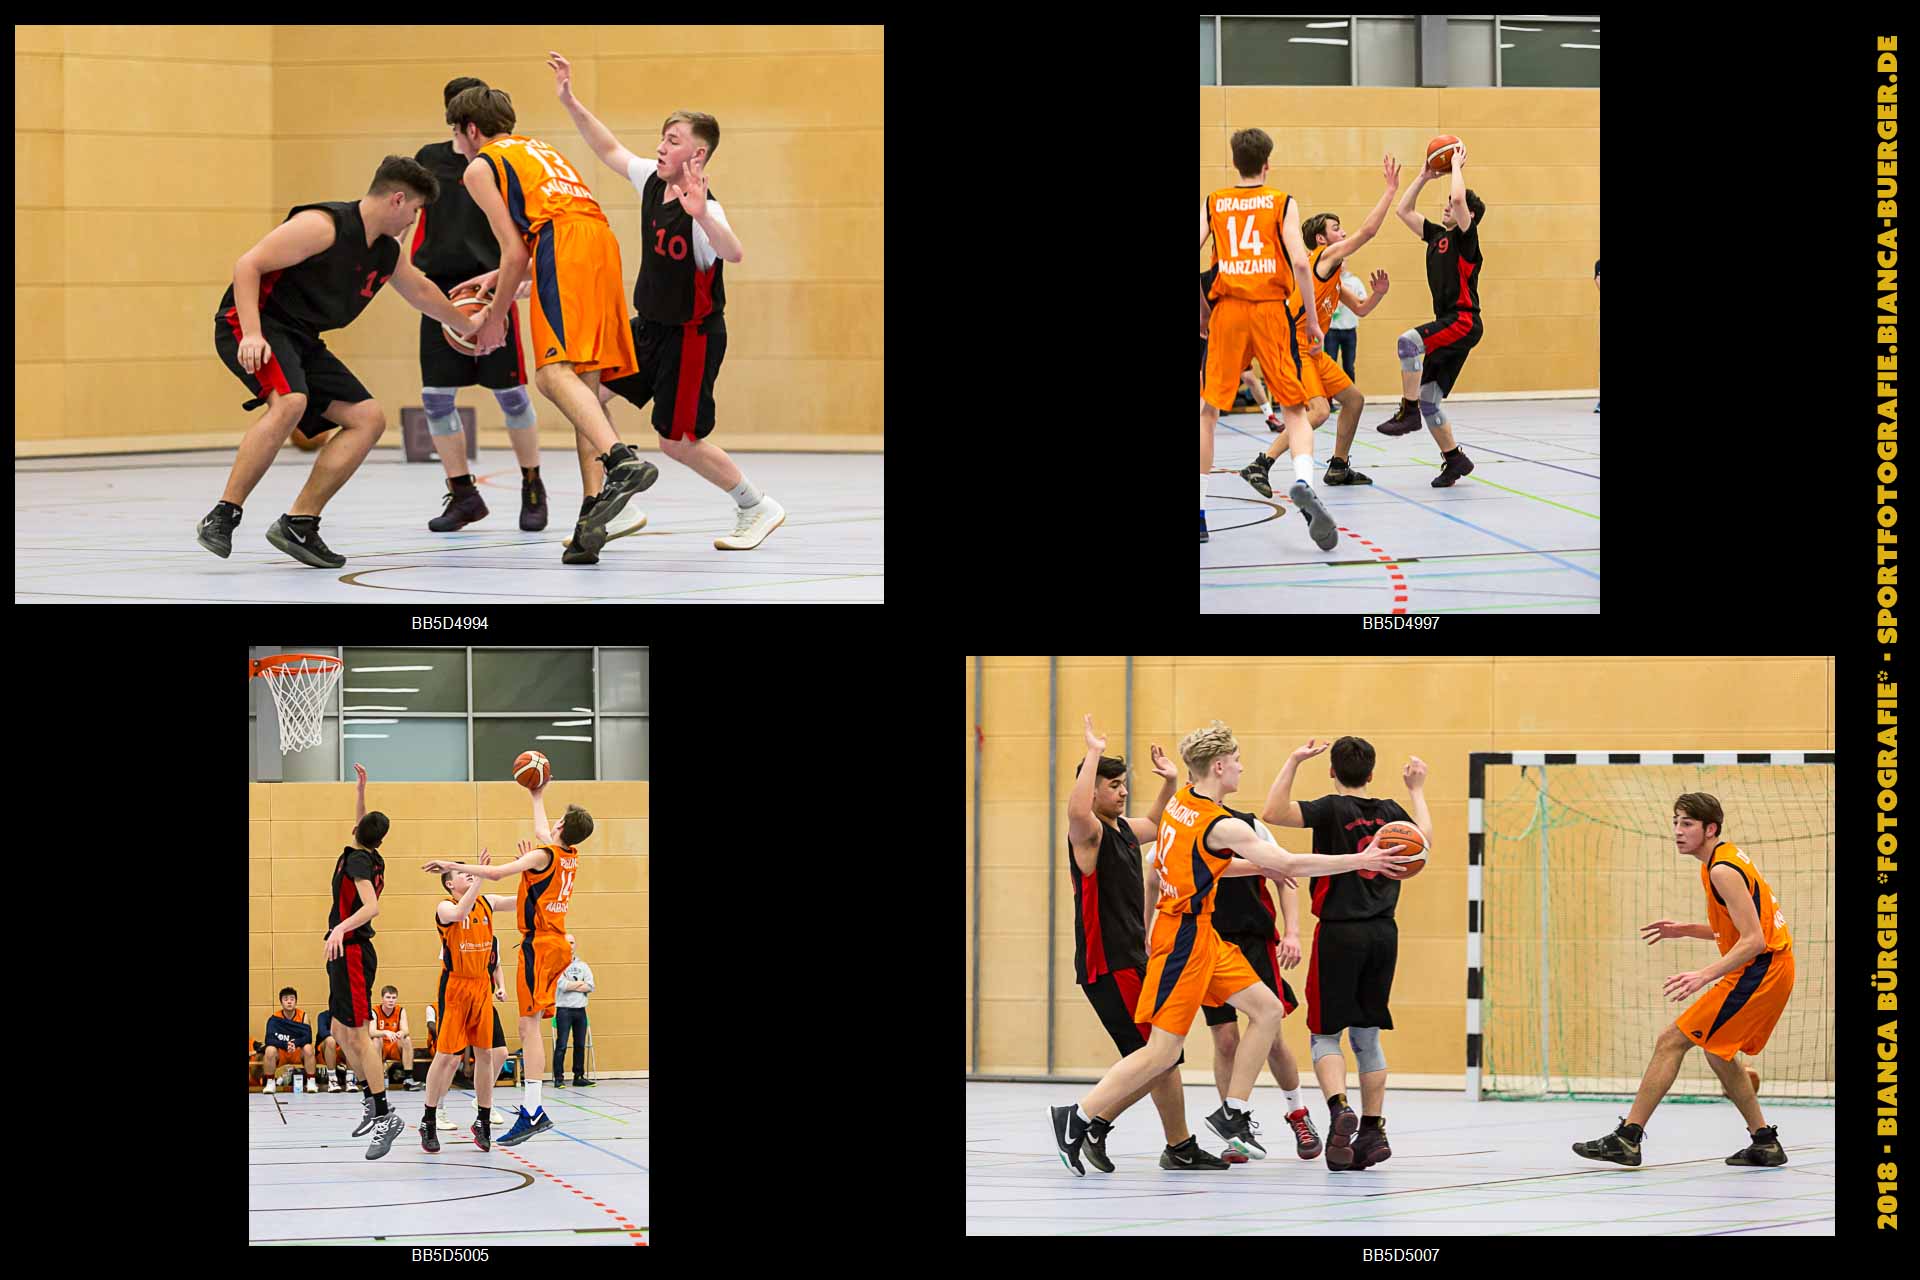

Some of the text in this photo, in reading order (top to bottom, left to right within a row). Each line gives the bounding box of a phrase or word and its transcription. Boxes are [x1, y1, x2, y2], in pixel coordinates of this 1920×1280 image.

[524, 145, 580, 183] 13
[1215, 194, 1275, 213] DRAGONS
[654, 229, 688, 261] 10
[1226, 214, 1265, 258] 14
[1438, 237, 1449, 254] 9
[1217, 259, 1277, 275] MARZAHN
[1164, 794, 1201, 827] RAGONS
